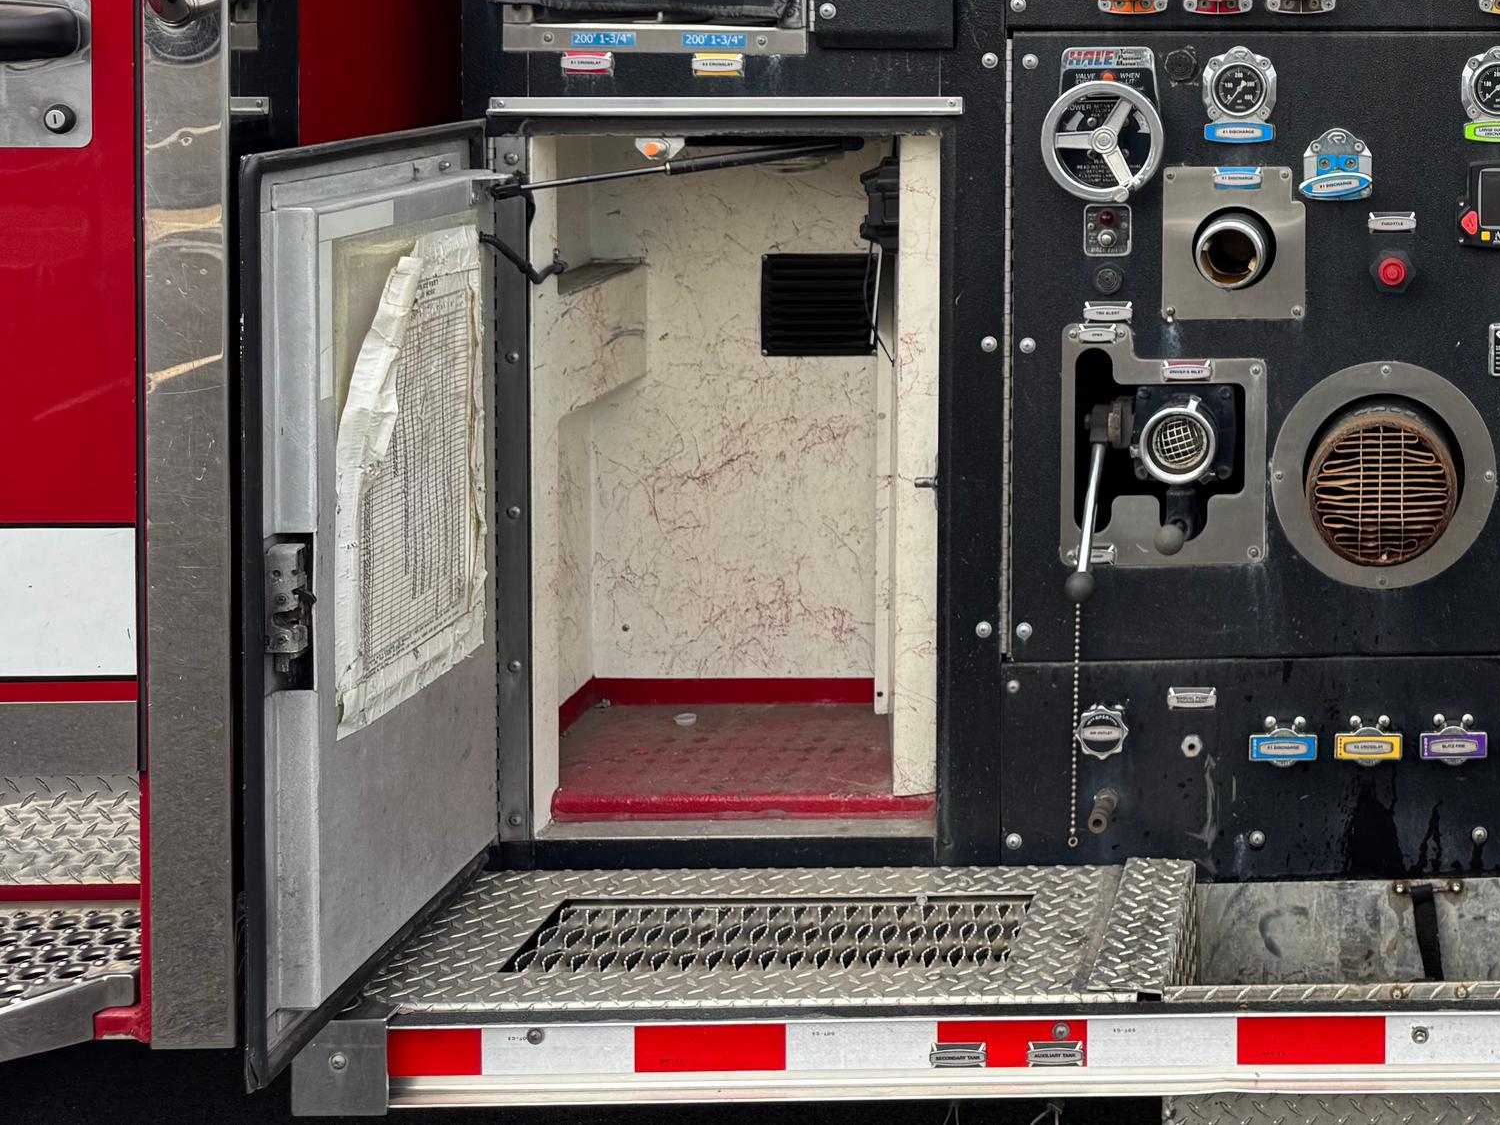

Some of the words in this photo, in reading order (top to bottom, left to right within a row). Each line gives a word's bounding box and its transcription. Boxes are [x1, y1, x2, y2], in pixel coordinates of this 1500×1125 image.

[574, 34, 596, 43] 200'
[600, 34, 632, 43] 1-3/4"
[686, 34, 708, 44] 200'
[711, 34, 743, 44] 1-3/4"
